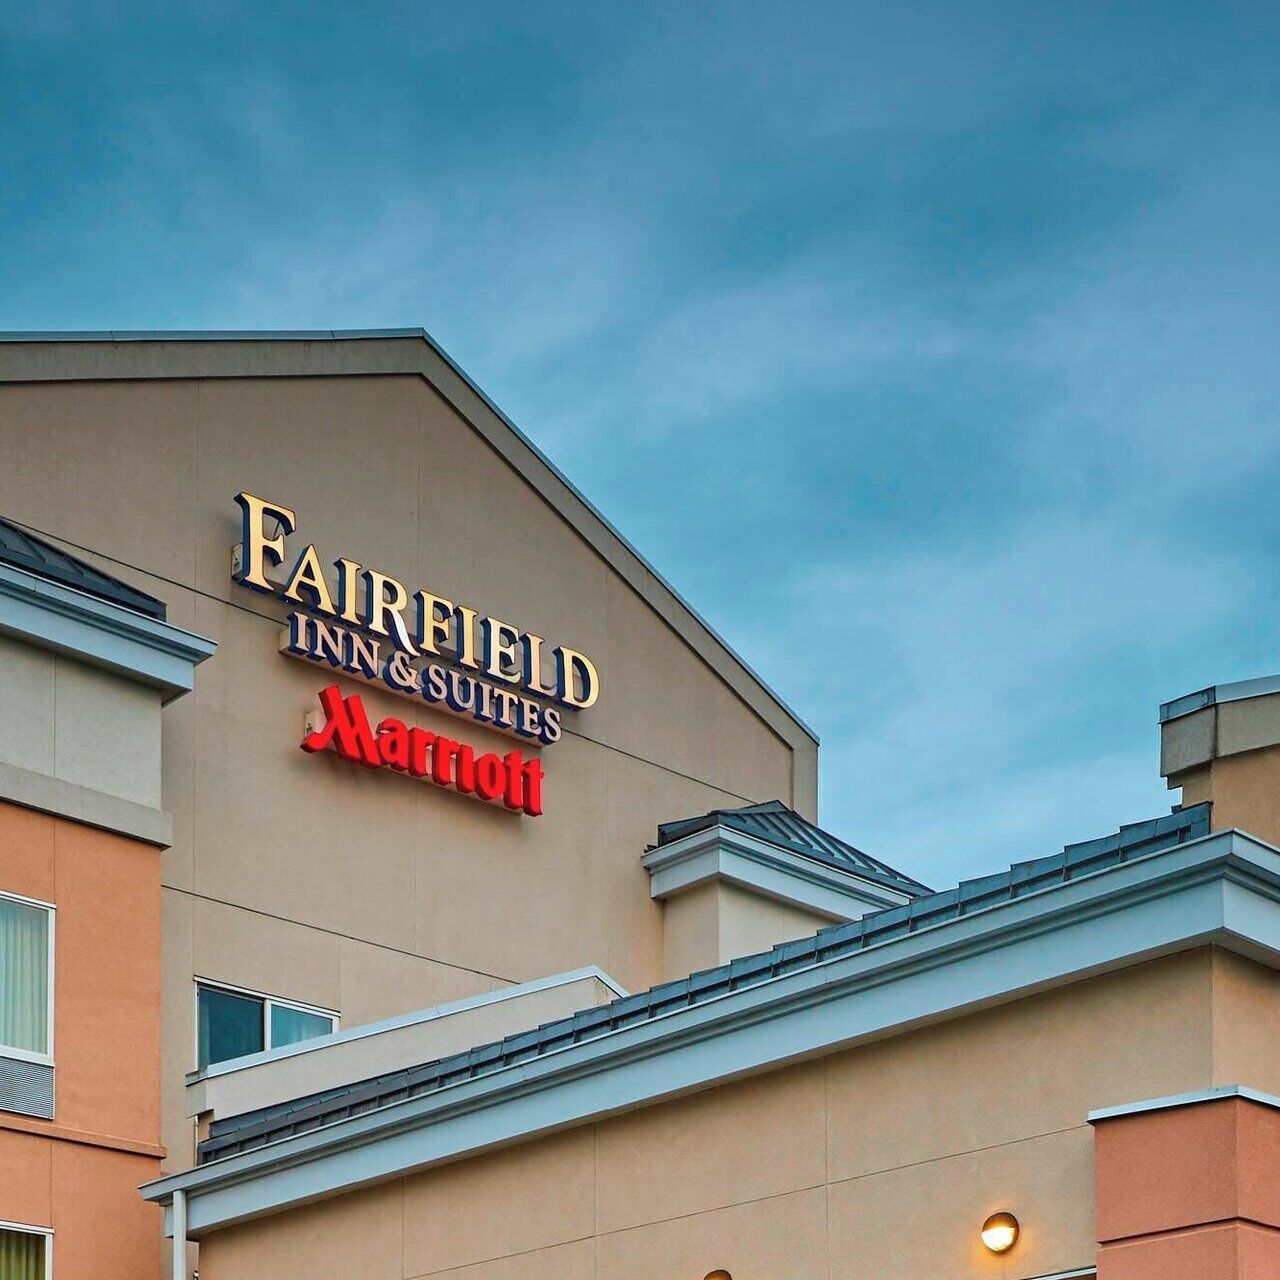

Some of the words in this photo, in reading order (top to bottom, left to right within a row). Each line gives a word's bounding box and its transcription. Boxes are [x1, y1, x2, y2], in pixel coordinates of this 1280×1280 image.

[234, 491, 601, 711] FAIRFIELD
[287, 611, 382, 679] INN
[387, 650, 421, 693] &
[421, 663, 562, 746] SUITES
[300, 684, 545, 816] Marriott
